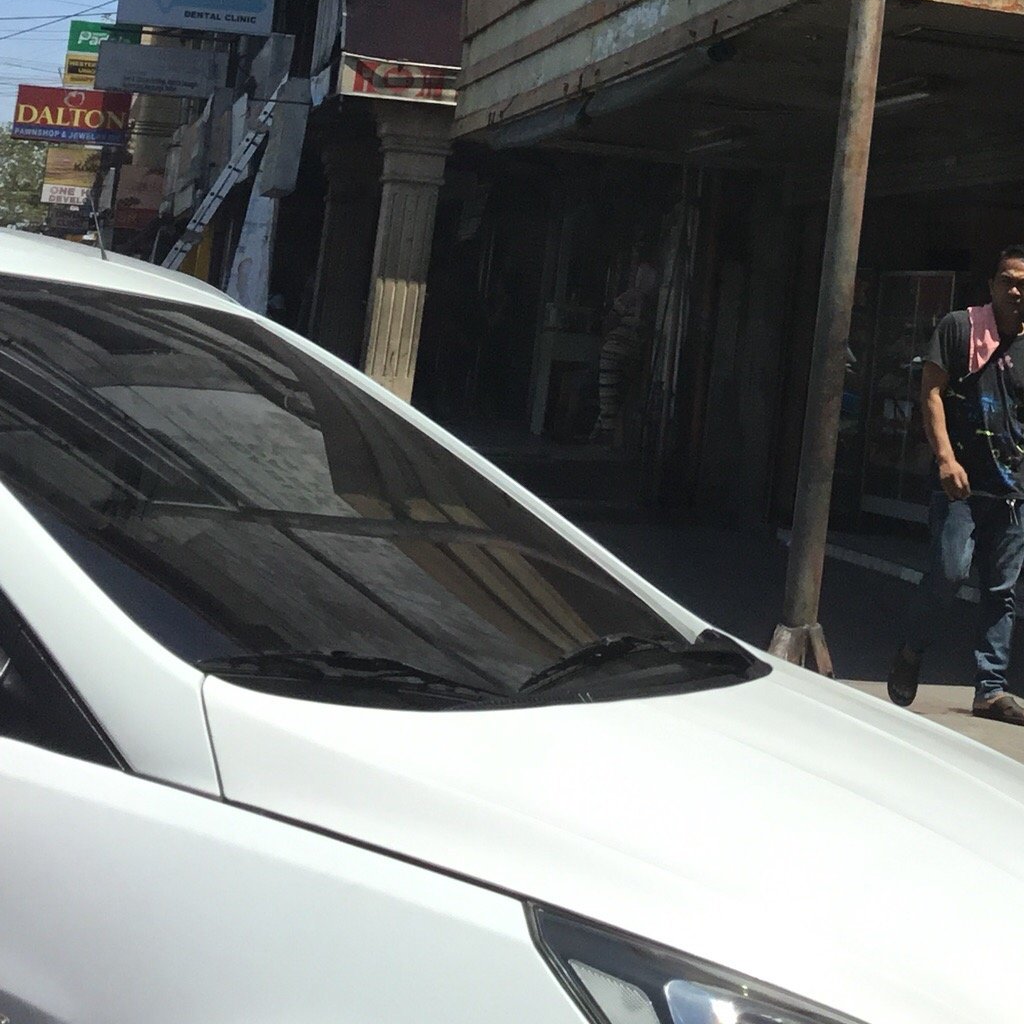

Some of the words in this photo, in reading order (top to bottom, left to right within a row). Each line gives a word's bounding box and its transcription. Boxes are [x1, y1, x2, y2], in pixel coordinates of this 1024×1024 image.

[184, 10, 221, 21] DENTAL
[224, 14, 257, 25] CLINIC
[16, 103, 127, 129] DALTON
[14, 127, 60, 137] PAWNSHOP
[49, 186, 75, 196] ONE
